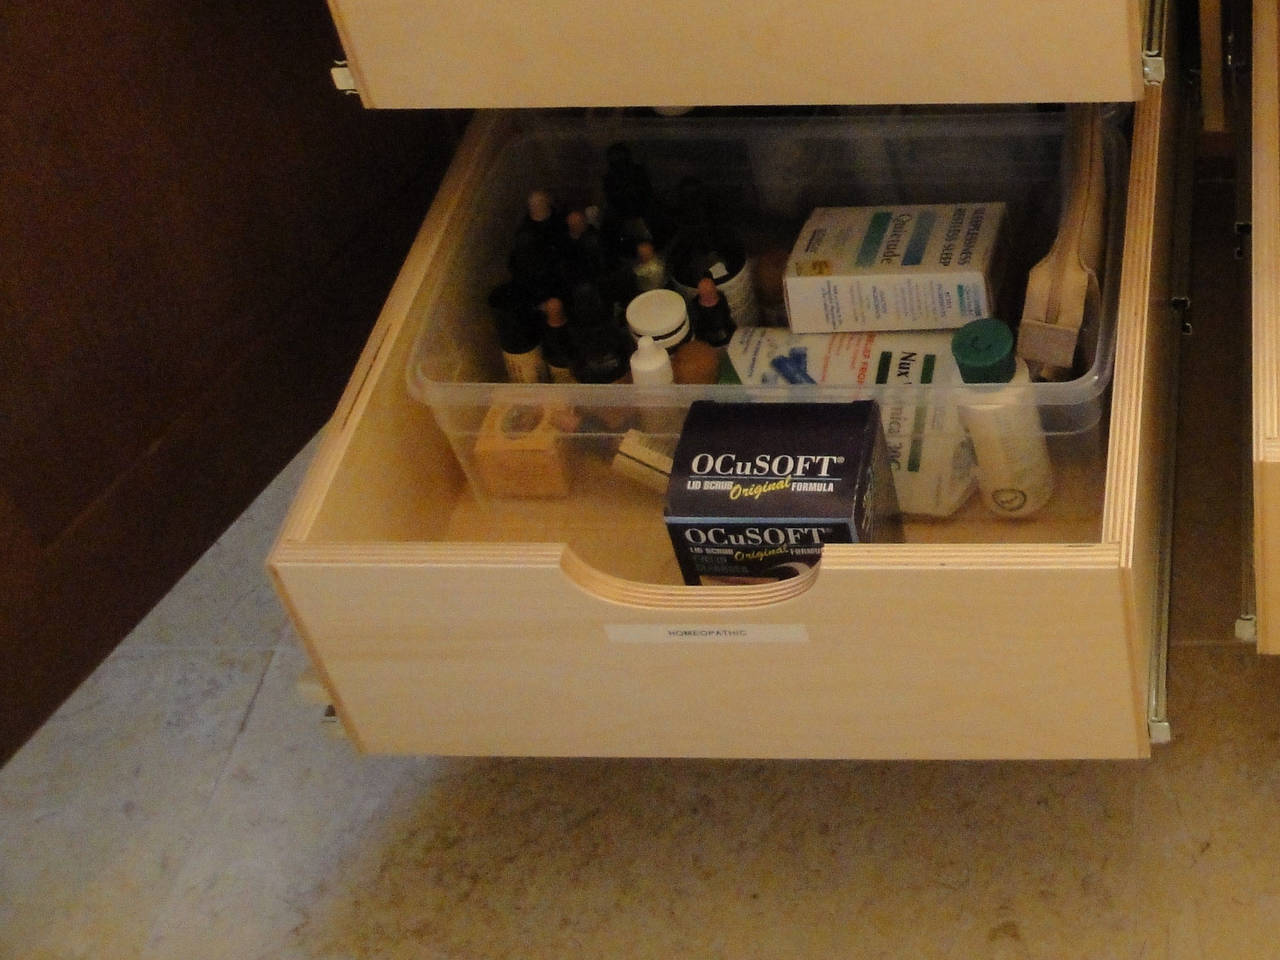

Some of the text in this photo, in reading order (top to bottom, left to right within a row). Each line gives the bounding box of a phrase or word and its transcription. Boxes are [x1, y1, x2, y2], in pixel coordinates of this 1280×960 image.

[880, 213, 913, 265] Quietude
[897, 351, 917, 377] Nux
[687, 475, 834, 500] LID SCRUB Original FORMULA
[734, 544, 790, 561] Original
